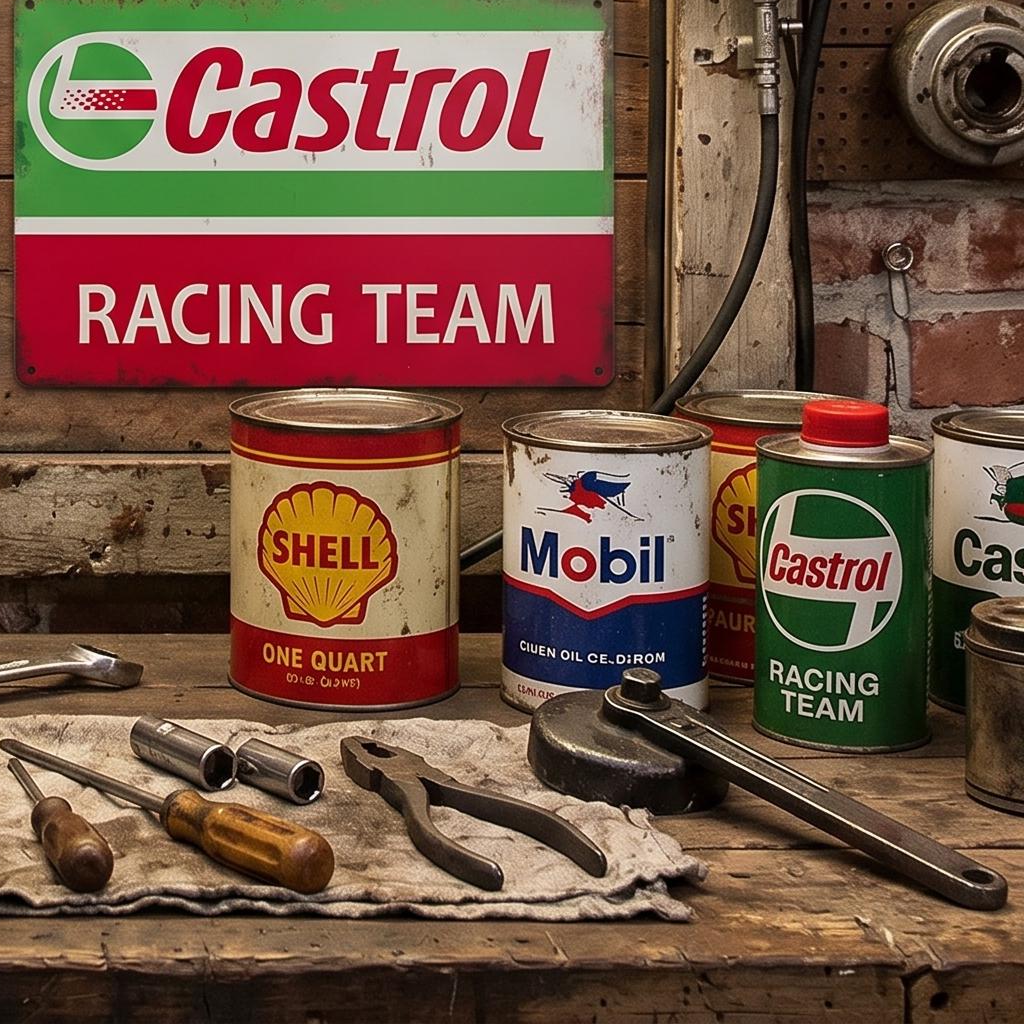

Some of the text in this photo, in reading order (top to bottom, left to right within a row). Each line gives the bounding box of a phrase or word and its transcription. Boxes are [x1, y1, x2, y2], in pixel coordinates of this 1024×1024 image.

[165, 46, 552, 155] Castrol
[78, 282, 556, 345] RACING TEAM
[272, 529, 380, 570] SHELL
[520, 526, 665, 584] Mobil
[768, 542, 893, 592] Castrol
[263, 642, 389, 673] ONE QUART
[560, 649, 584, 662] OIL
[769, 658, 880, 696] RACING
[780, 689, 865, 723] TEAM
